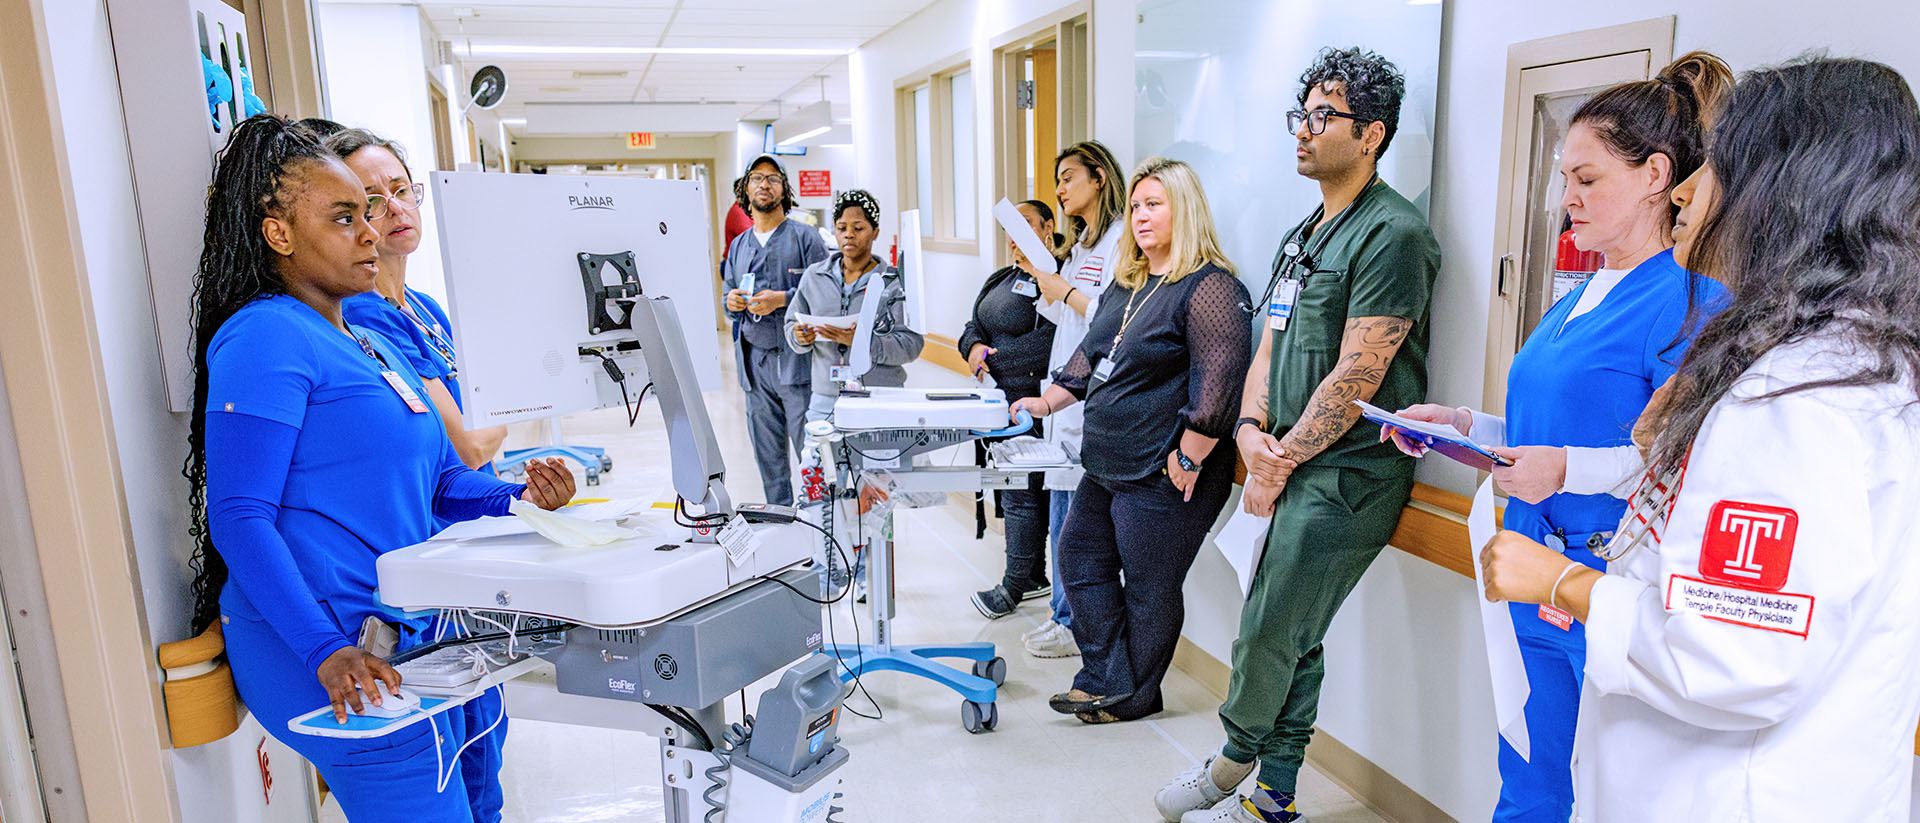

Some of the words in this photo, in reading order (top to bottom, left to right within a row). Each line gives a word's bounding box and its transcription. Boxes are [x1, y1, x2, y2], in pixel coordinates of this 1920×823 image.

[631, 132, 651, 146] EXIT
[568, 195, 614, 206] PLANAR
[1683, 584, 1759, 606] Medicine/Hospital
[1760, 596, 1798, 612] Medicine
[1540, 604, 1570, 622] REGISTERED
[1684, 597, 1714, 612] Temple
[1715, 602, 1747, 619] Faculty
[1748, 607, 1793, 625] Physicians
[1545, 613, 1562, 626] NURSE
[608, 678, 637, 690] EcoFlex
